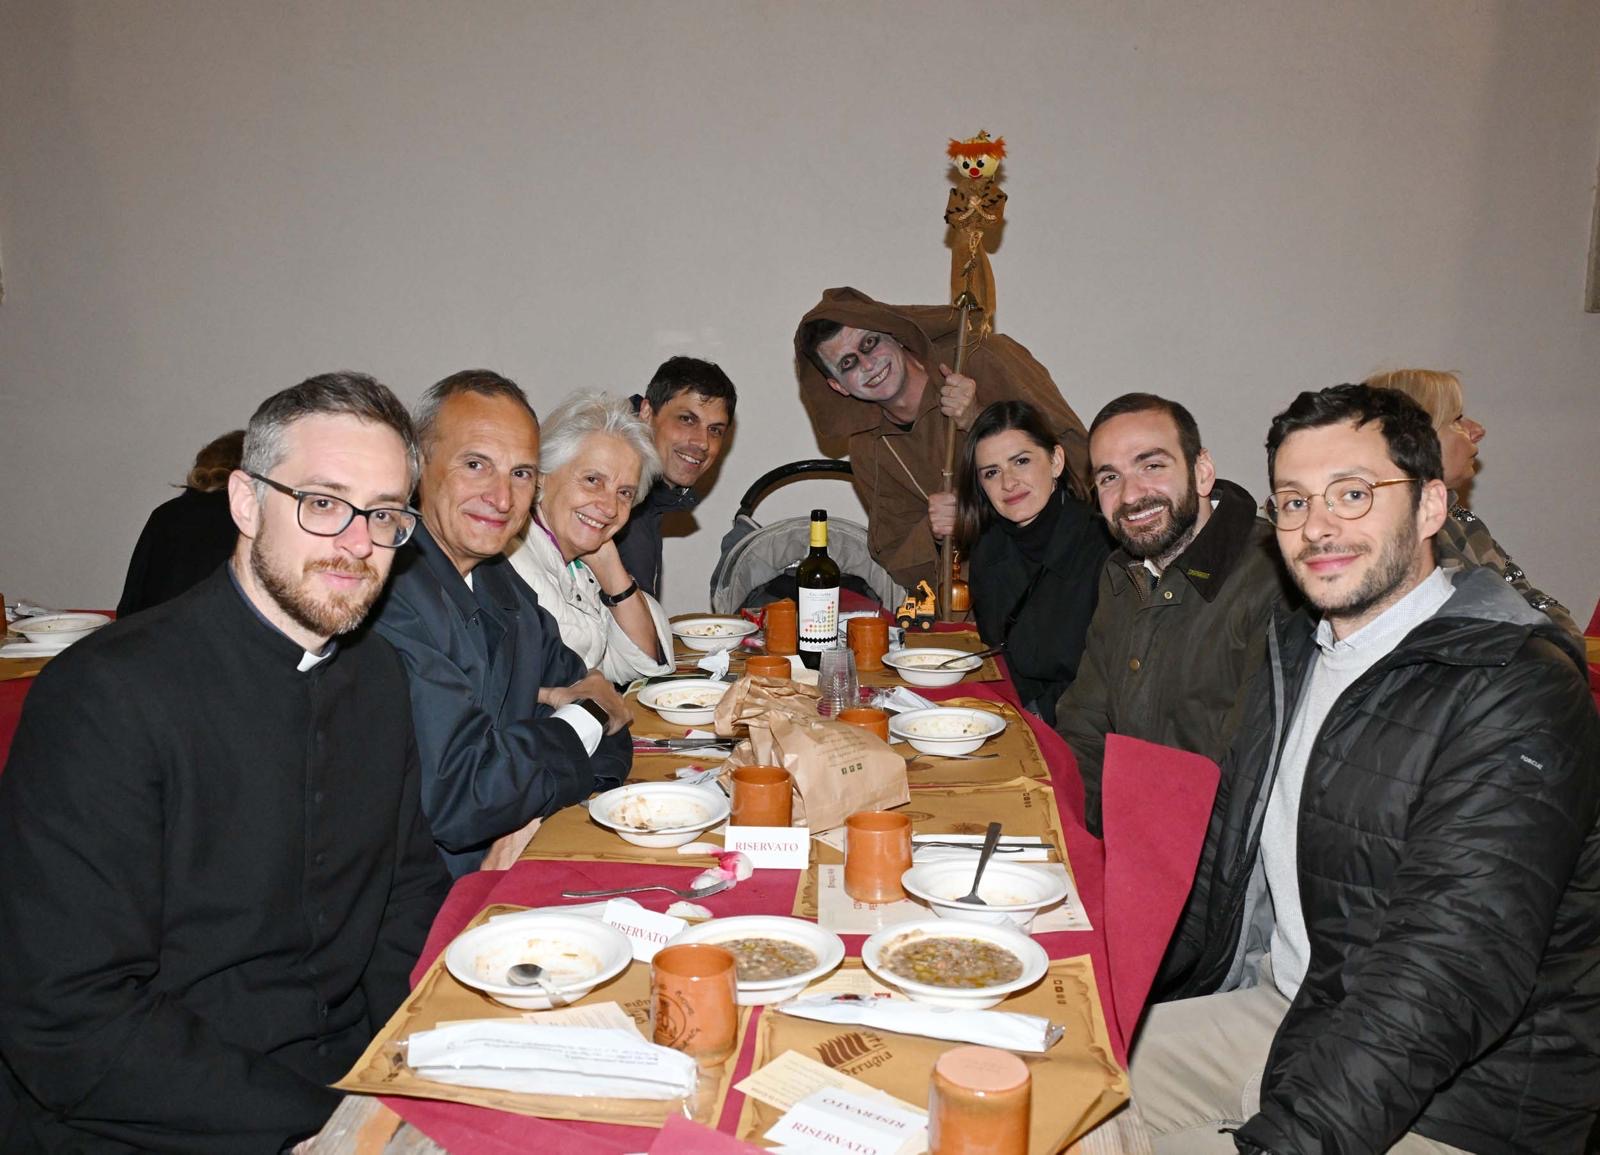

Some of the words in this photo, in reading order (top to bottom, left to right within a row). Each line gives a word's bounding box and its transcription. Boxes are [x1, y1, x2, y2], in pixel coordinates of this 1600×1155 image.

[735, 841, 799, 852] RISERVATO
[610, 920, 669, 945] RISERVATO
[791, 1121, 877, 1155] RISERVATO
